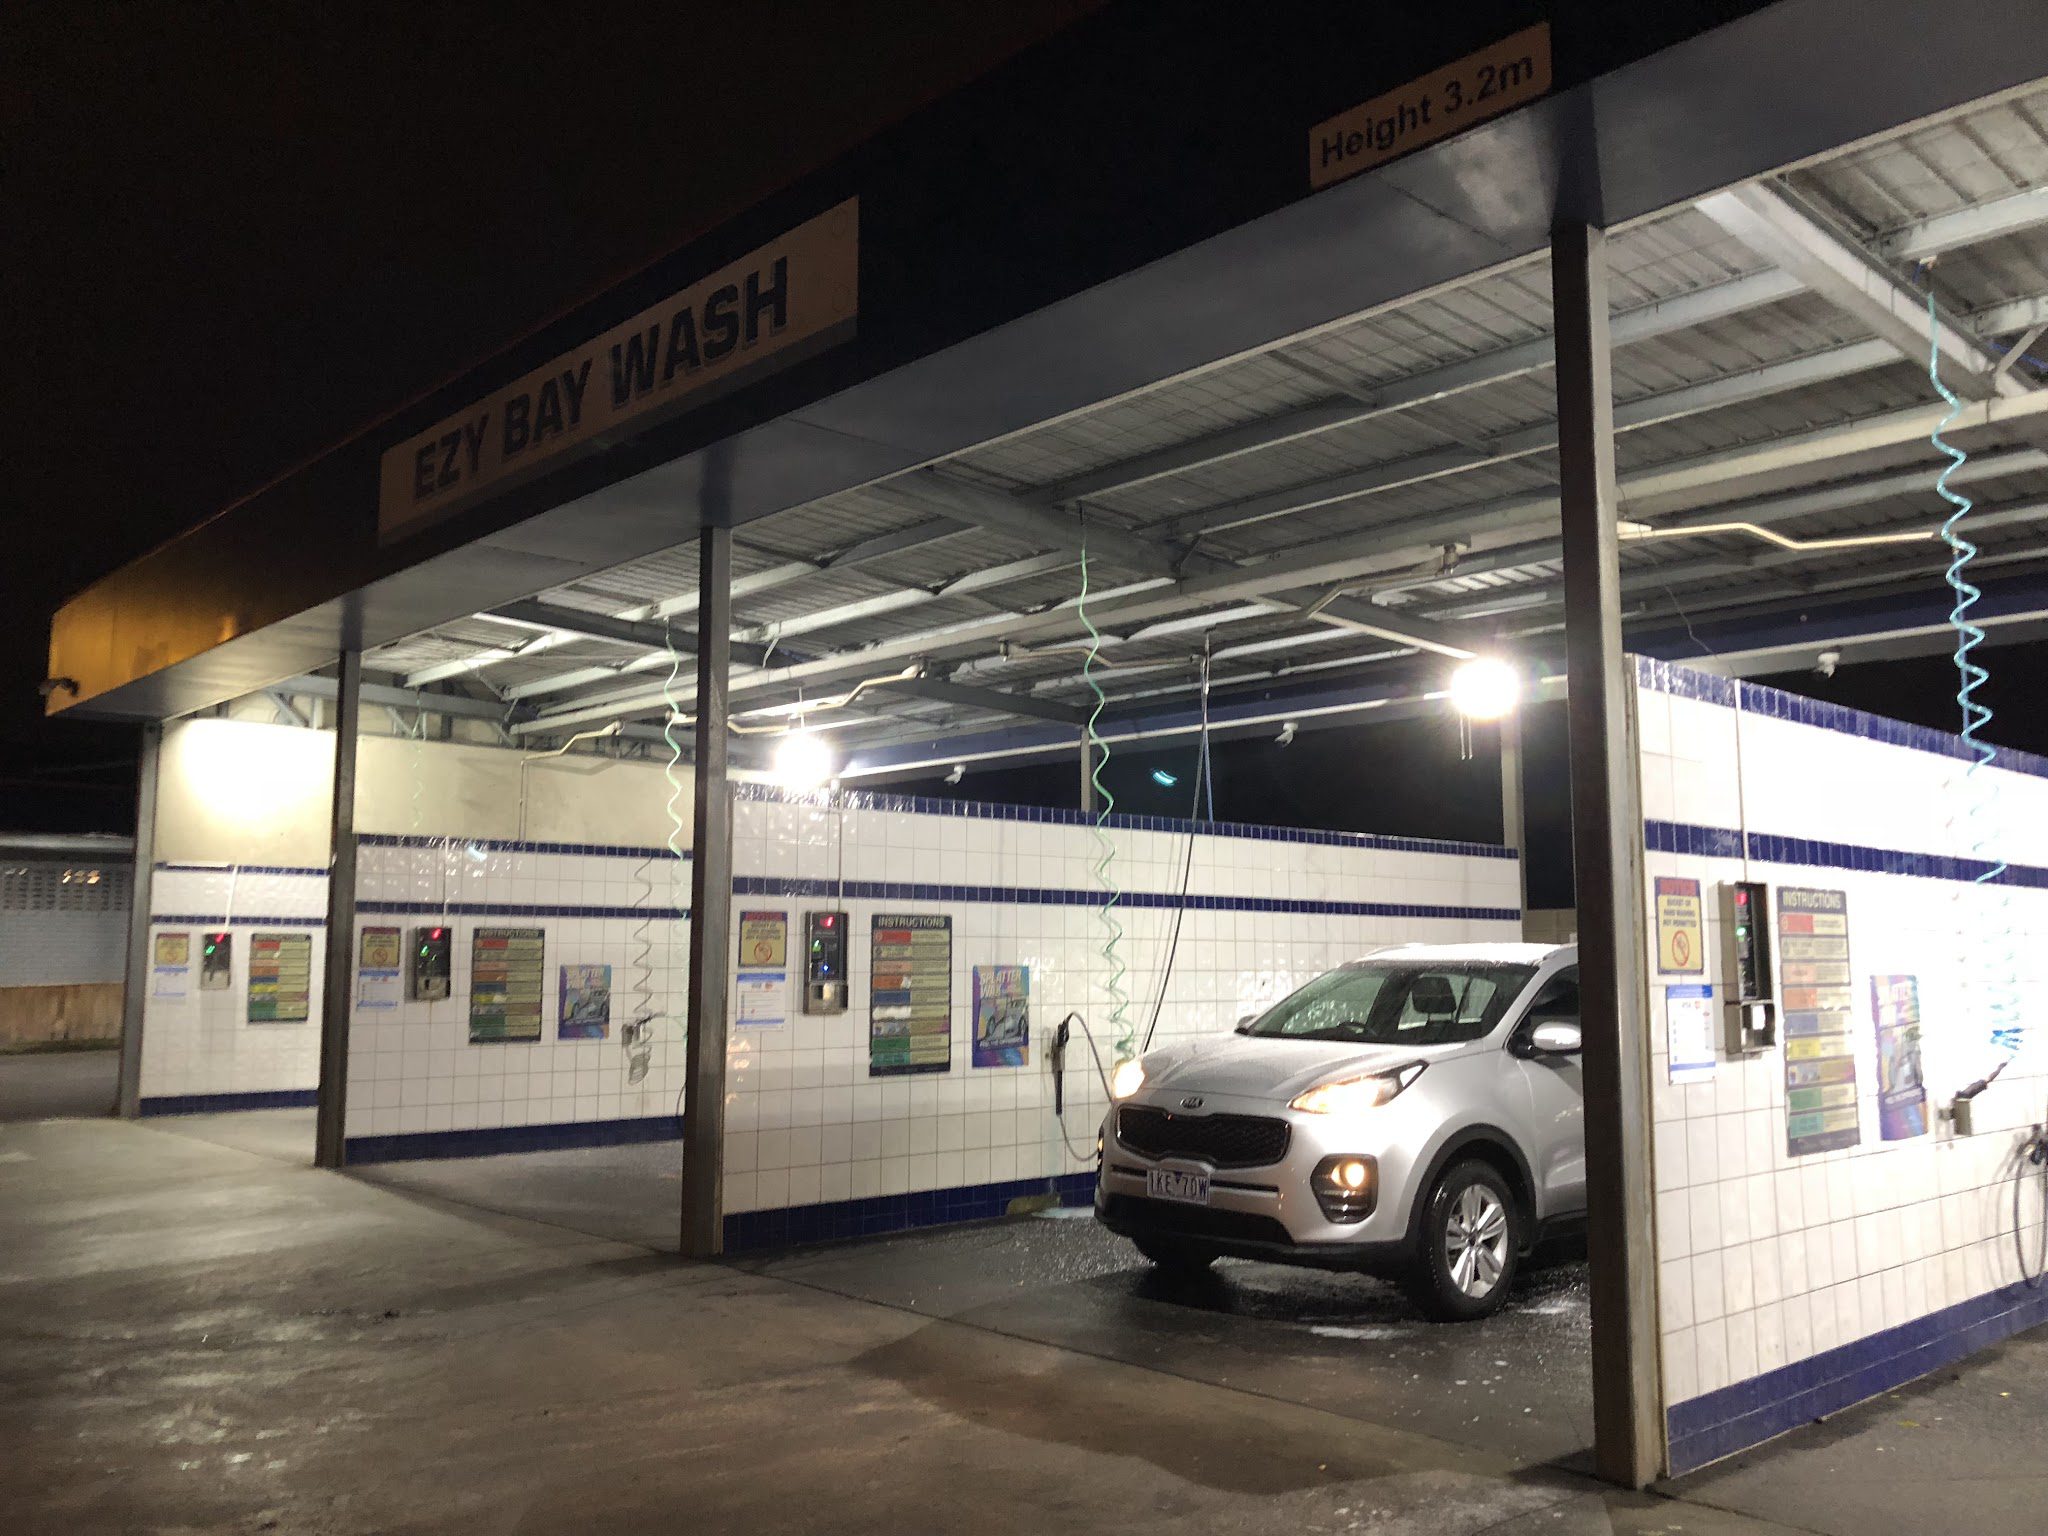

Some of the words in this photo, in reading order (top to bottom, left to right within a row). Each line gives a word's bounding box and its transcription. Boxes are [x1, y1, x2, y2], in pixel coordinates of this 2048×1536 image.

[1320, 94, 1432, 167] Height
[1444, 56, 1534, 114] 3.2m
[414, 414, 491, 500] EZY
[503, 359, 593, 457] BAY
[611, 256, 789, 410] WASH
[877, 915, 945, 929] INSTRUCTIONS
[1782, 890, 1842, 911] INSTRUCTIONS
